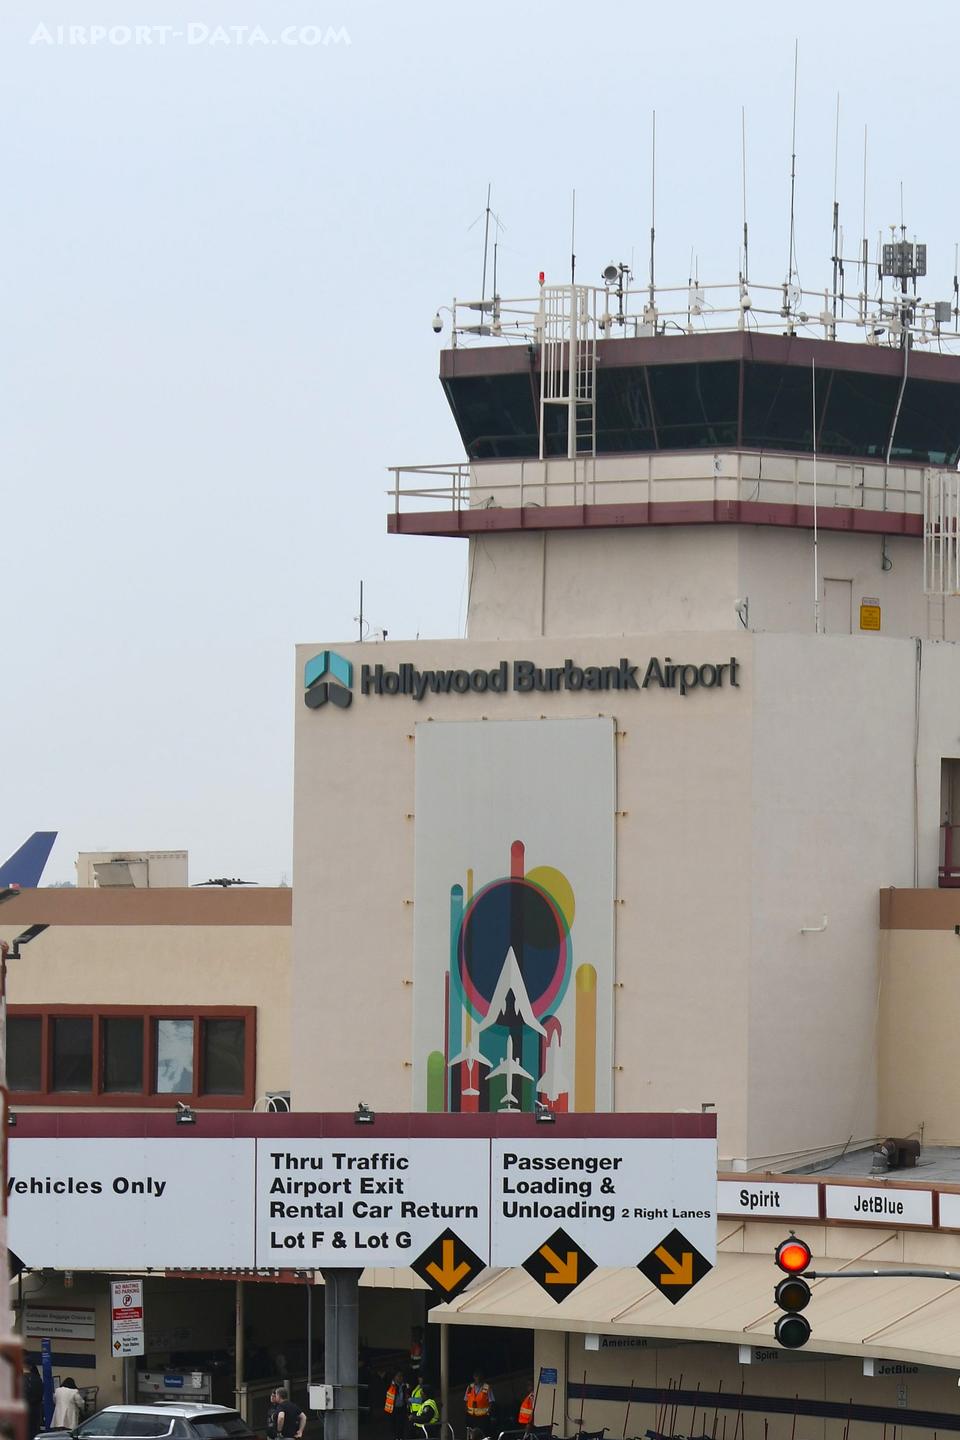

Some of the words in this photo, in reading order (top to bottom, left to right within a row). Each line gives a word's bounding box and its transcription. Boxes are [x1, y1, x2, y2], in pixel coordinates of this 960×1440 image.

[360, 661, 508, 700] Hollywood
[513, 658, 640, 692] Burbank
[641, 656, 740, 695] Airport
[270, 1153, 323, 1170] Thru
[332, 1153, 409, 1170] Traffic
[503, 1153, 623, 1174] Passenger
[112, 1177, 167, 1197] Only
[269, 1177, 352, 1198] Airport
[360, 1177, 404, 1194] Exit
[503, 1177, 592, 1198] Loading
[599, 1177, 616, 1194] &
[270, 1201, 344, 1218] Rental
[352, 1201, 393, 1218] Car
[401, 1201, 479, 1218] Return
[739, 1189, 780, 1210] Spirit
[853, 1195, 904, 1215] JetBlue
[502, 1201, 616, 1222] Unloading
[621, 1208, 630, 1218] 2
[634, 1208, 669, 1220] Right
[672, 1208, 712, 1218] Lanes
[270, 1231, 305, 1249] Lot
[312, 1231, 325, 1249] F
[331, 1231, 347, 1249] &
[354, 1231, 389, 1249] Lot
[395, 1231, 412, 1249] G
[602, 1338, 648, 1348] American
[755, 1351, 778, 1361] Spirit
[878, 1364, 919, 1375] JetBlue
